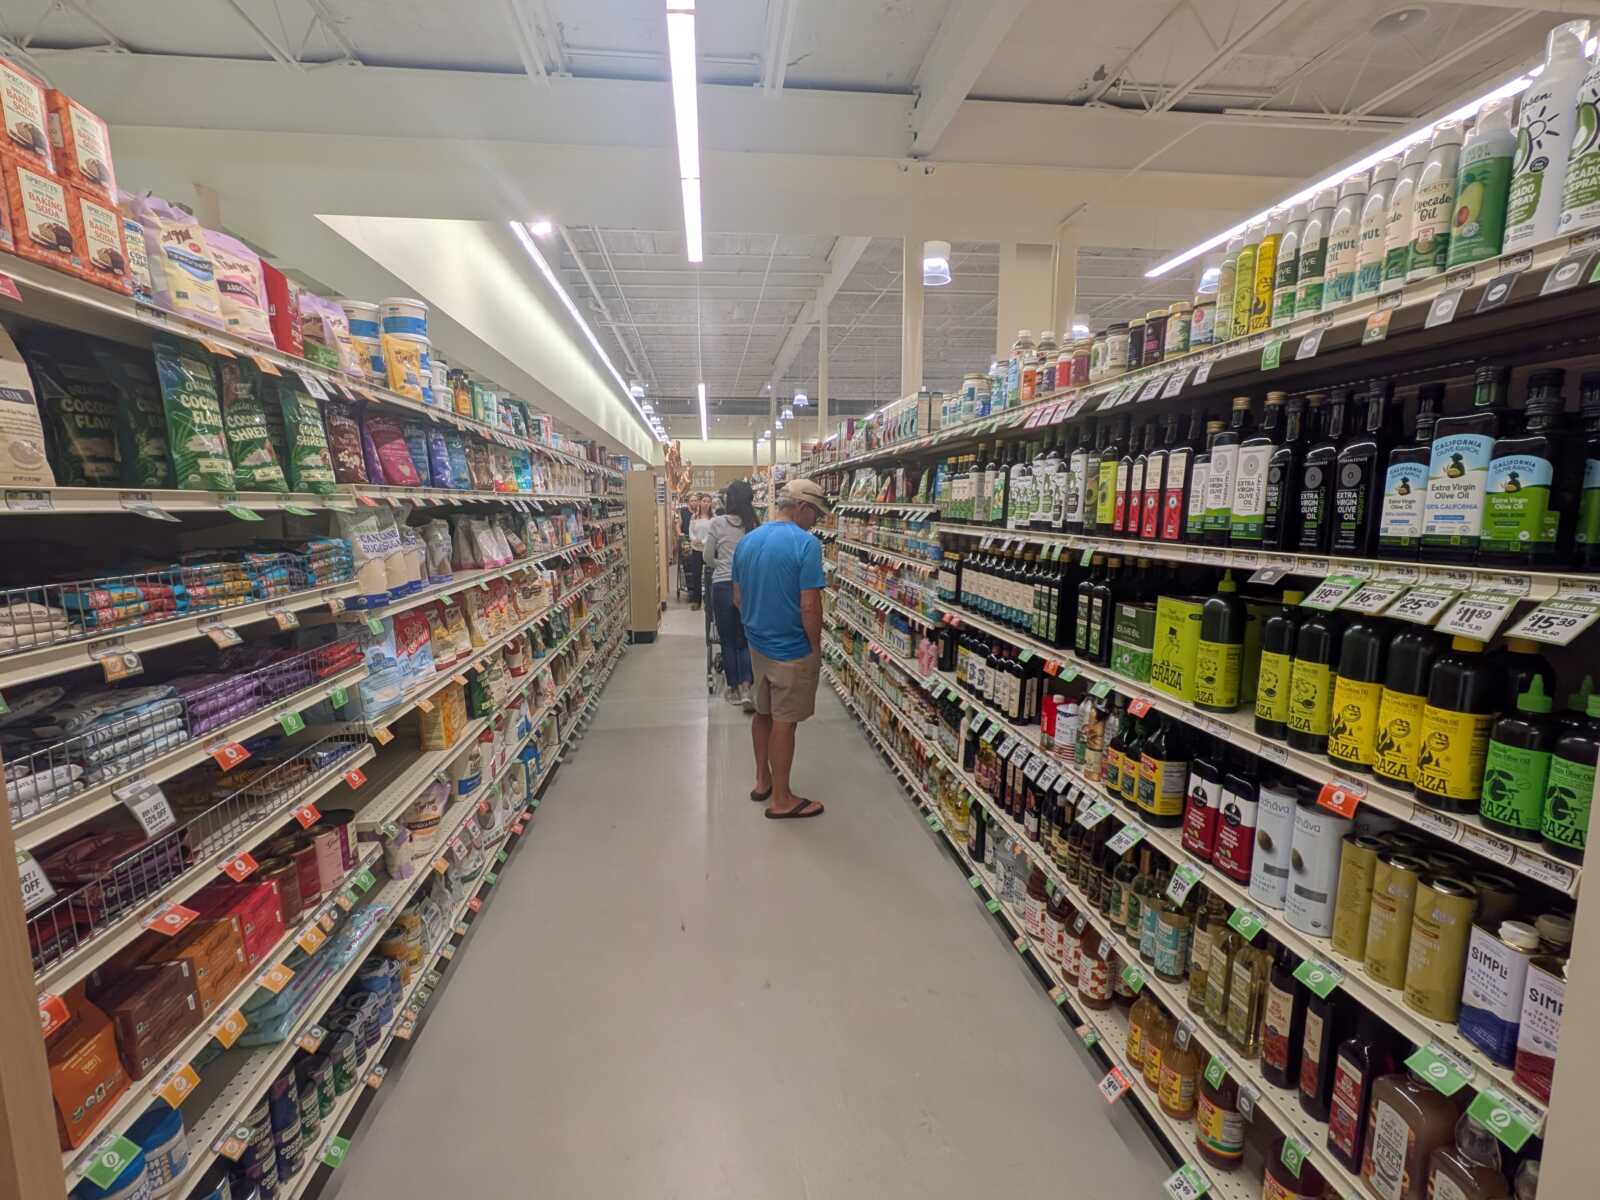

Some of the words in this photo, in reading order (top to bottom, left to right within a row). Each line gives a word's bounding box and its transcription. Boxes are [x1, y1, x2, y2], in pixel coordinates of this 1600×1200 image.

[28, 192, 63, 212] BAKING
[36, 203, 60, 218] SODA
[1419, 207, 1439, 222] Oil
[1434, 439, 1482, 452] CALIFORNIA
[1336, 491, 1357, 499] EXTRA
[1431, 483, 1451, 491] Extra
[1452, 483, 1476, 492] Virgin
[1434, 492, 1454, 500] Olive
[1457, 491, 1470, 500] Oil
[1151, 663, 1182, 691] GRAZA
[1328, 737, 1360, 761] RAZA
[156, 807, 167, 818] OFF
[24, 879, 41, 894] OFF
